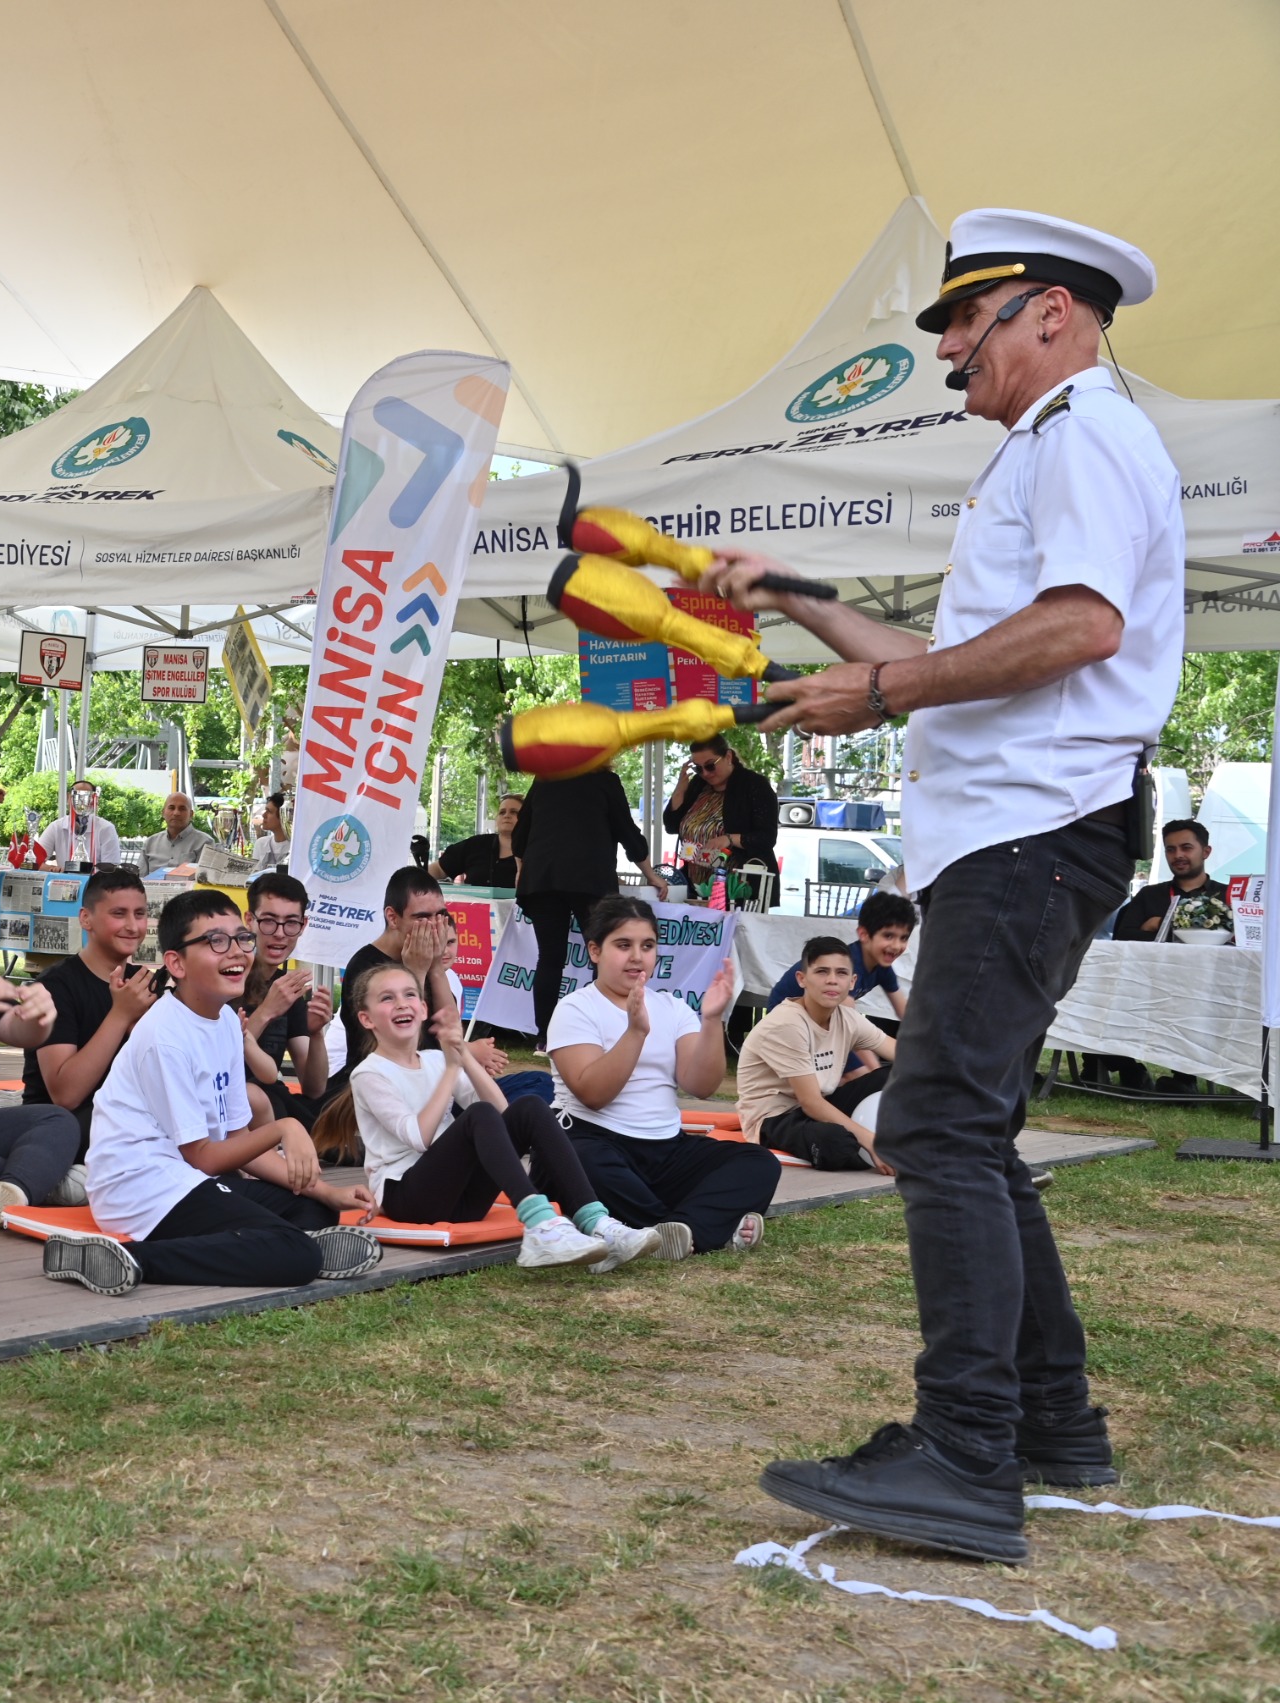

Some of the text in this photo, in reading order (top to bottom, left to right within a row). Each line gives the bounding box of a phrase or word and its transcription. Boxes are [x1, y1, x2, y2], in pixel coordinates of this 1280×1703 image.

[789, 410, 968, 449] ZEYREK
[1182, 477, 1248, 500] KANLIĞI
[470, 523, 549, 555] ANİSA
[730, 491, 892, 533] BELEDİYESİ
[95, 545, 301, 563] SOSYAL HİZMETLER DAİRESİ BAŞKANLIĞI
[589, 652, 647, 665] KURTARIN
[152, 684, 197, 698] SPOR KULÜBÜ
[317, 901, 376, 923] ZEYREK
[466, 957, 482, 965] ZOR
